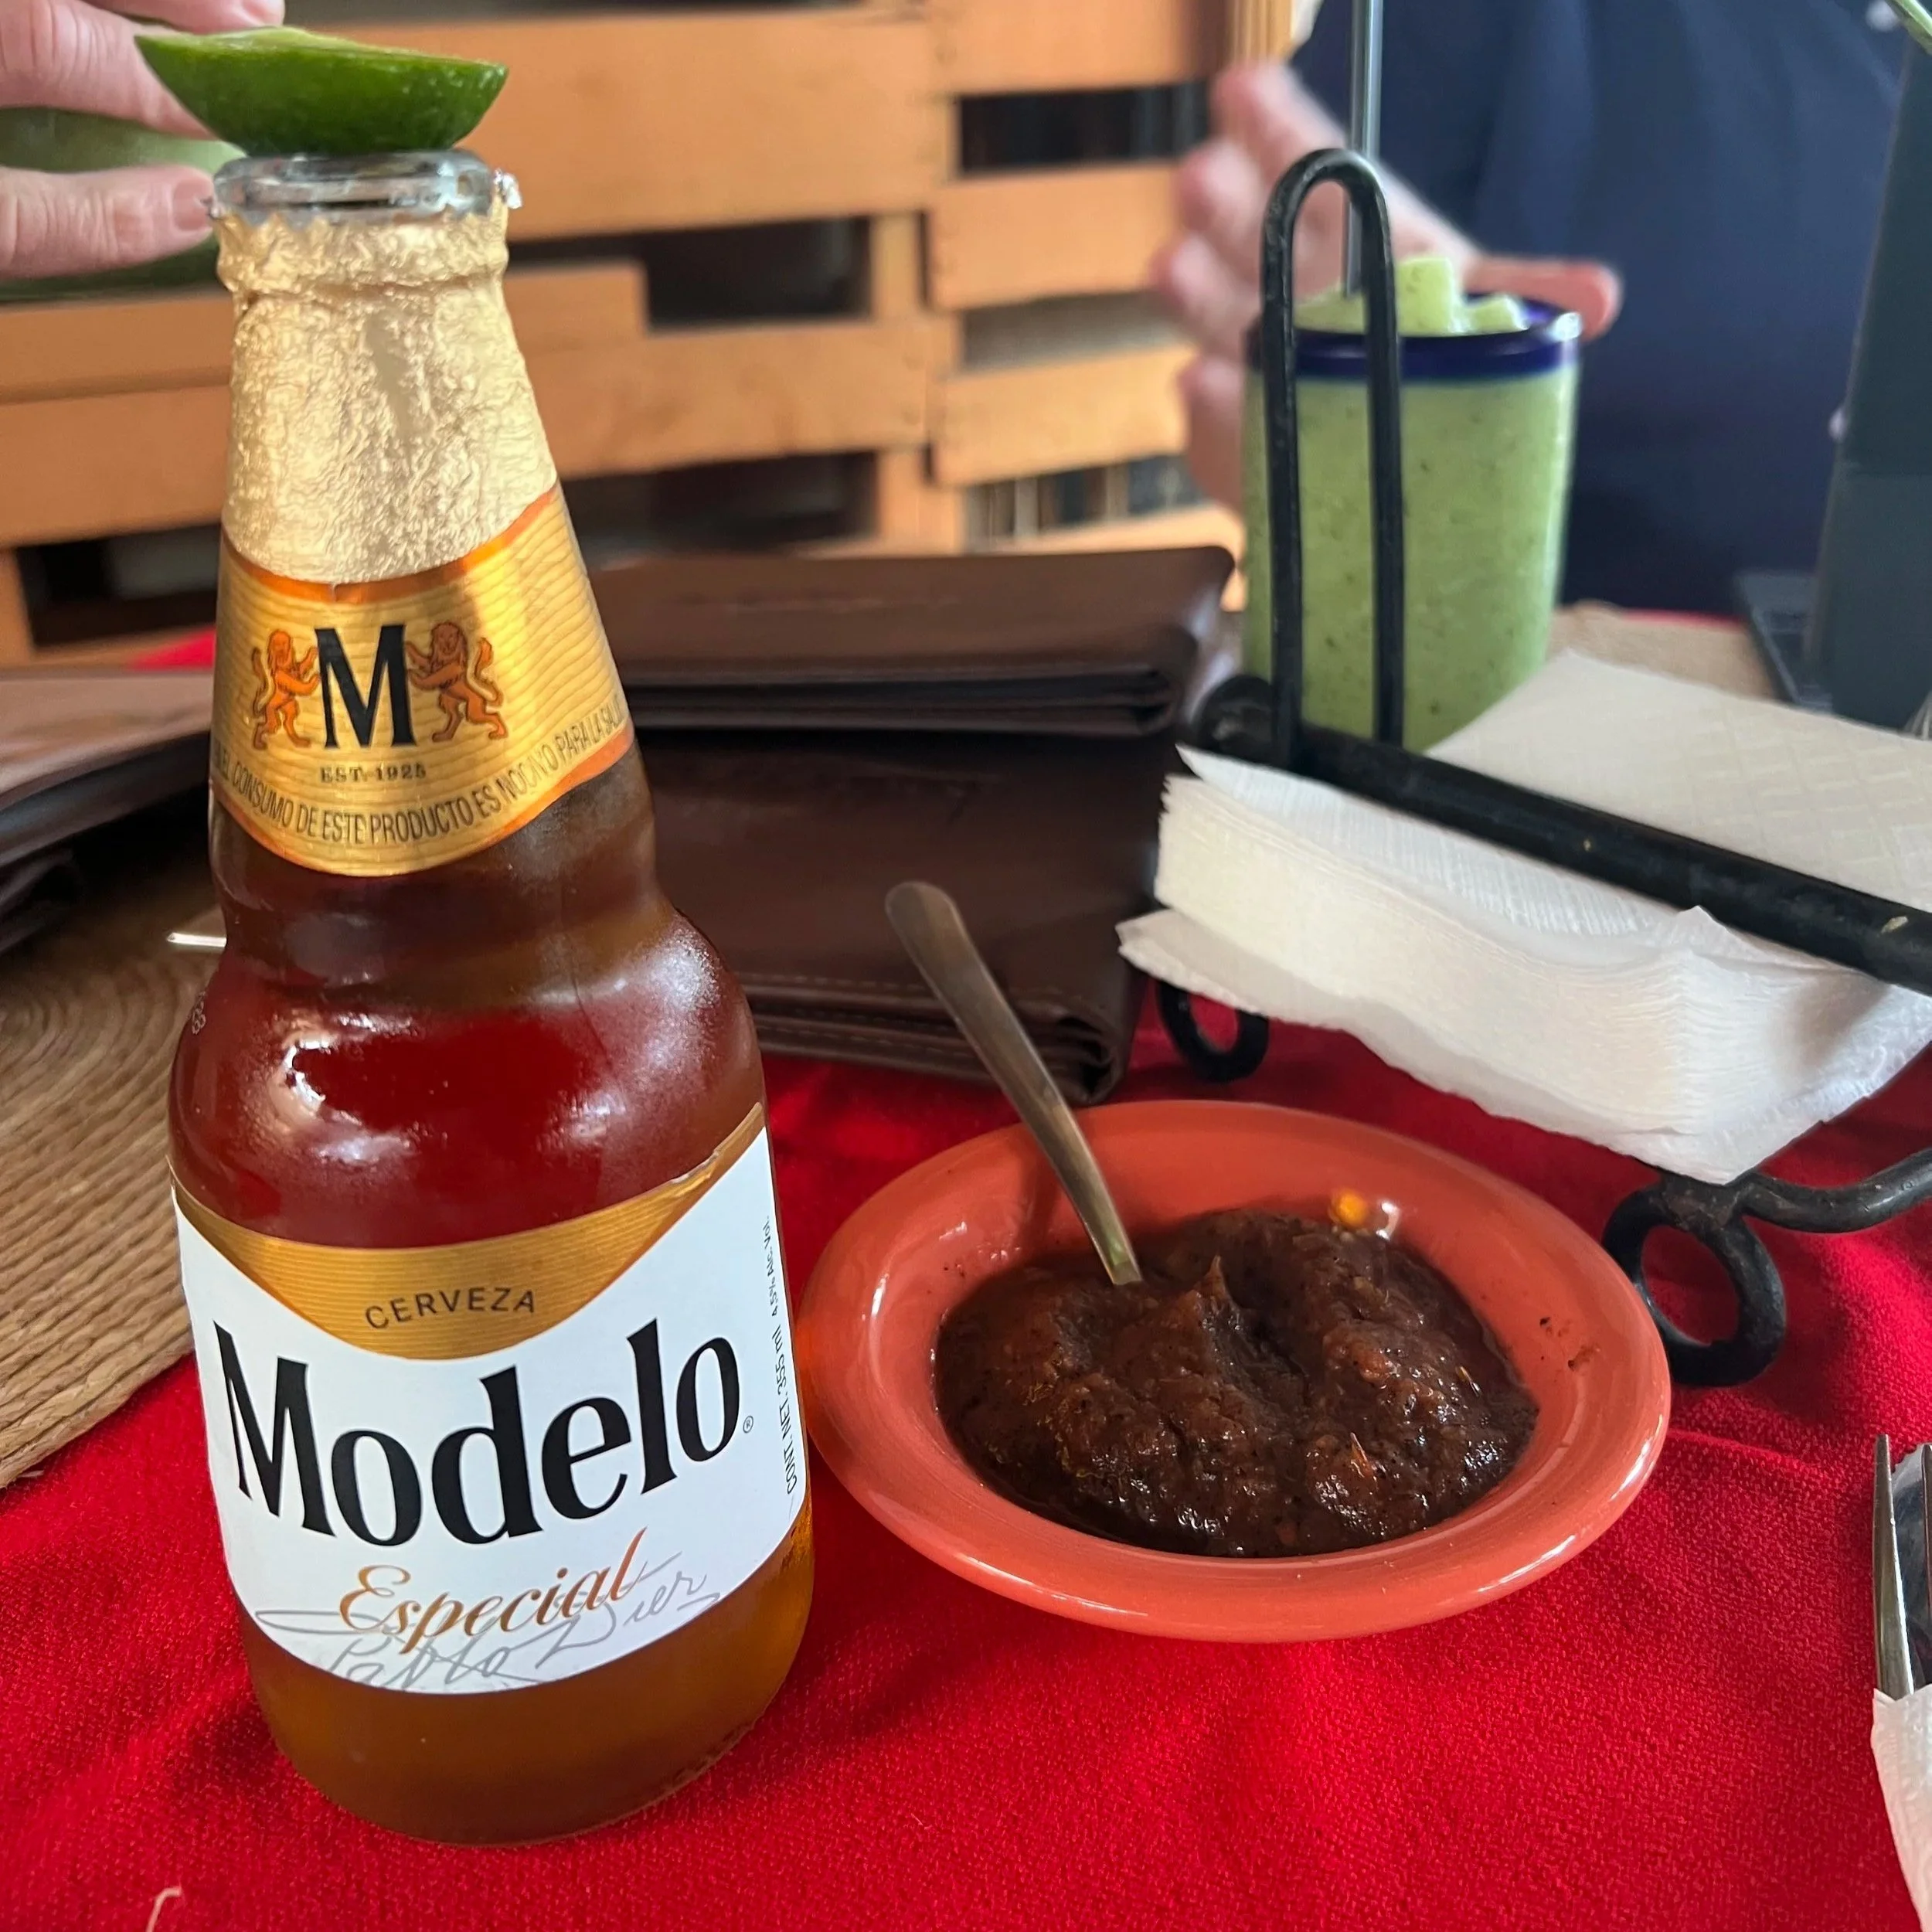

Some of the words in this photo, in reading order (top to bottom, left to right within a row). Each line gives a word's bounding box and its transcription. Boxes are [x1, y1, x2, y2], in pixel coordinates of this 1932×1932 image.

[315, 624, 417, 748] M
[376, 762, 427, 781] 1925
[233, 761, 294, 828] CONSUMO
[296, 801, 320, 838] DE
[321, 808, 366, 845] ESTE
[369, 795, 474, 845] PRODUCTO
[471, 784, 502, 819] ES
[365, 1287, 536, 1329] CERVEZA
[772, 1325, 783, 1354] ml
[775, 1354, 787, 1395] 355
[213, 1318, 740, 1546] Modelo
[779, 1391, 791, 1440] NET.
[784, 1434, 797, 1495] CONT.
[339, 1526, 648, 1655] Especial
